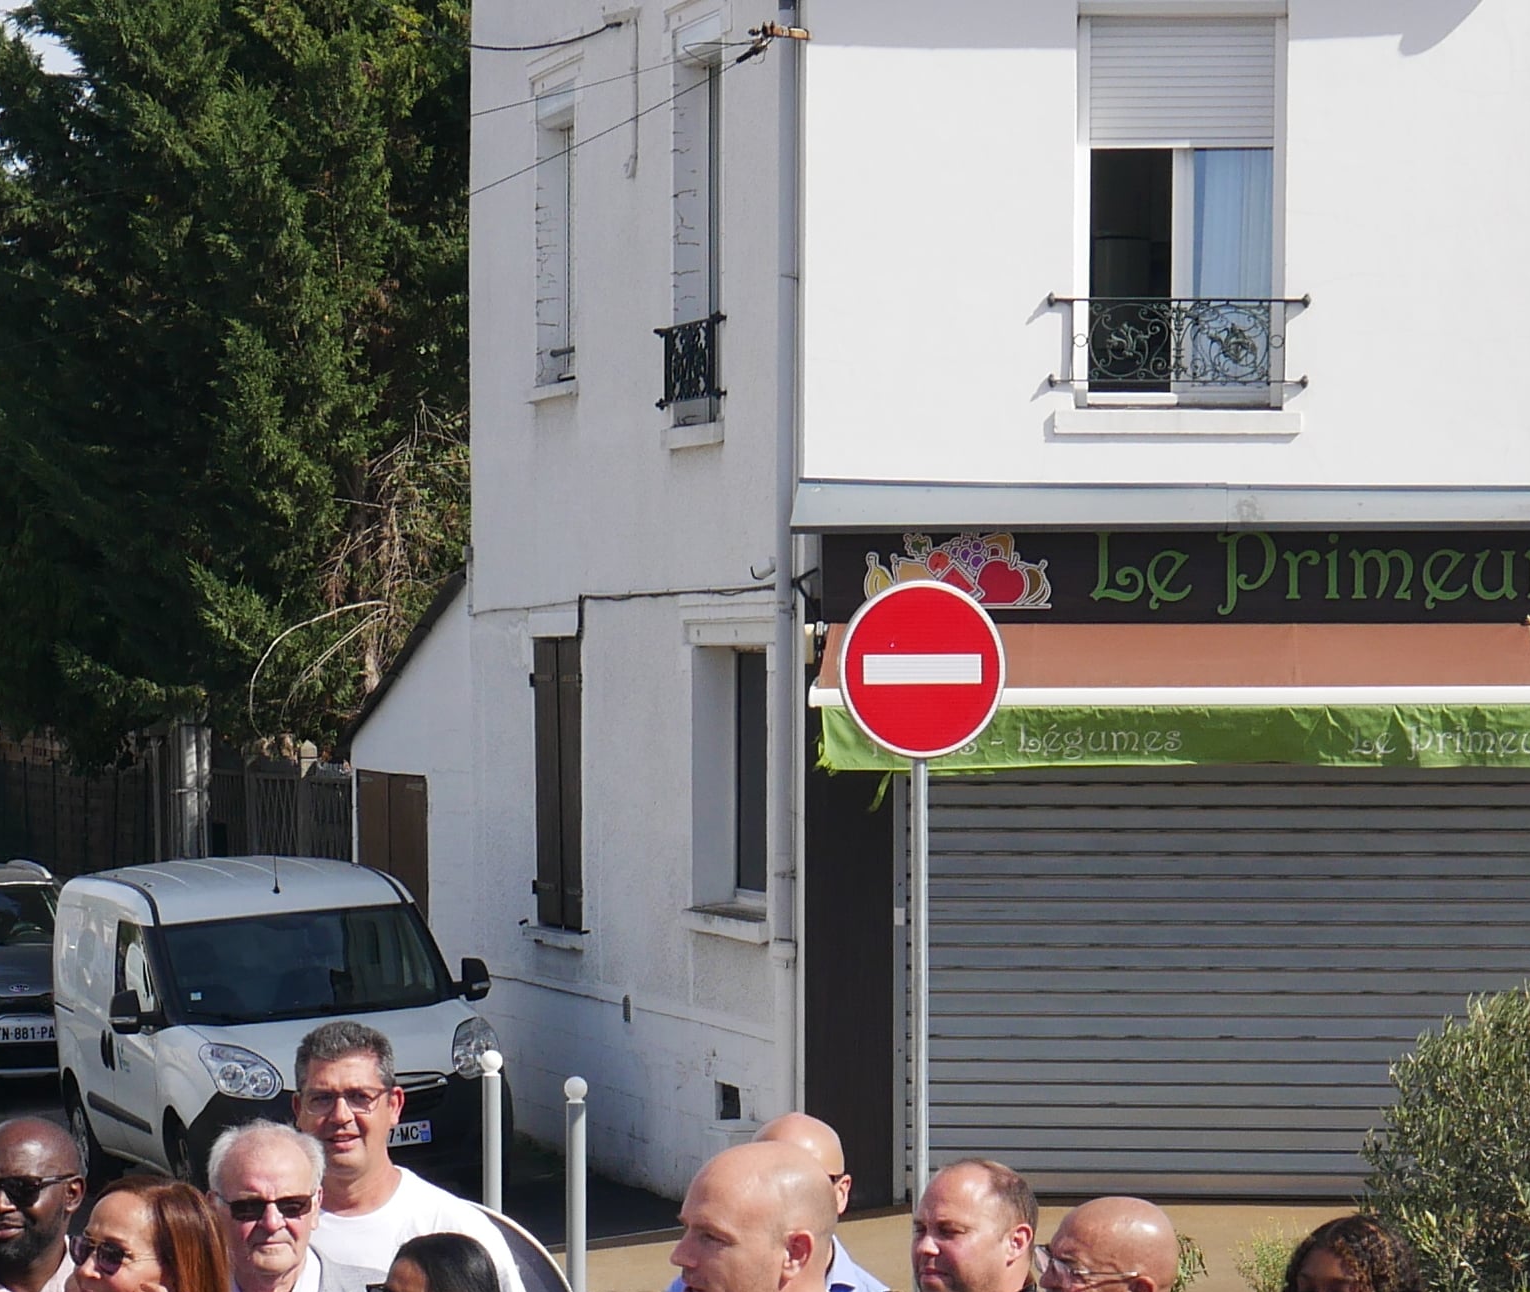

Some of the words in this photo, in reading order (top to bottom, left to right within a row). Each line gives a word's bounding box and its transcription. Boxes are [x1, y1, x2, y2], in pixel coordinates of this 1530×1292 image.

[1089, 531, 1194, 610] Le
[1017, 723, 1184, 761] Légumes
[1349, 725, 1397, 758] Le
